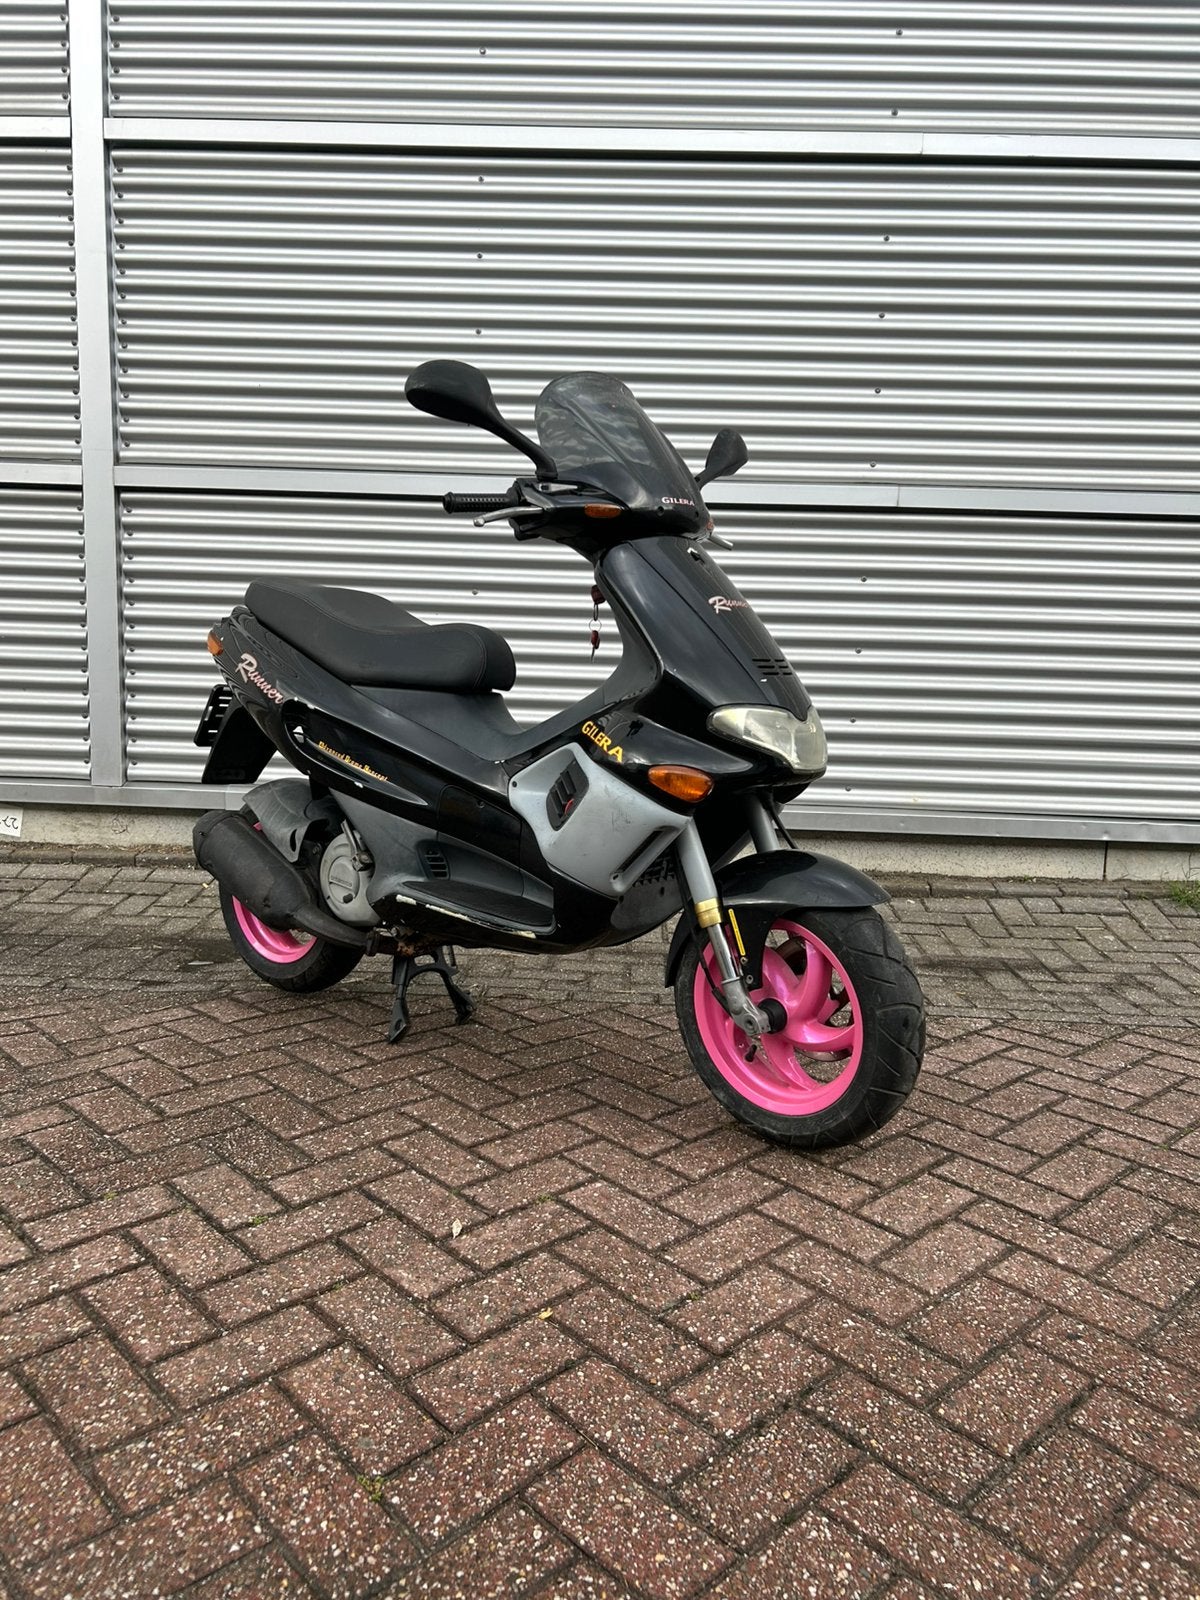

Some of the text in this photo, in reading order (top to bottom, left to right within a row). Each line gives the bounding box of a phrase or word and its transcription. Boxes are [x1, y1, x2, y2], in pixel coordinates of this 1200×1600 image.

[661, 496, 695, 507] GILERA
[235, 652, 284, 704] Runner
[581, 720, 623, 763] GILERA
